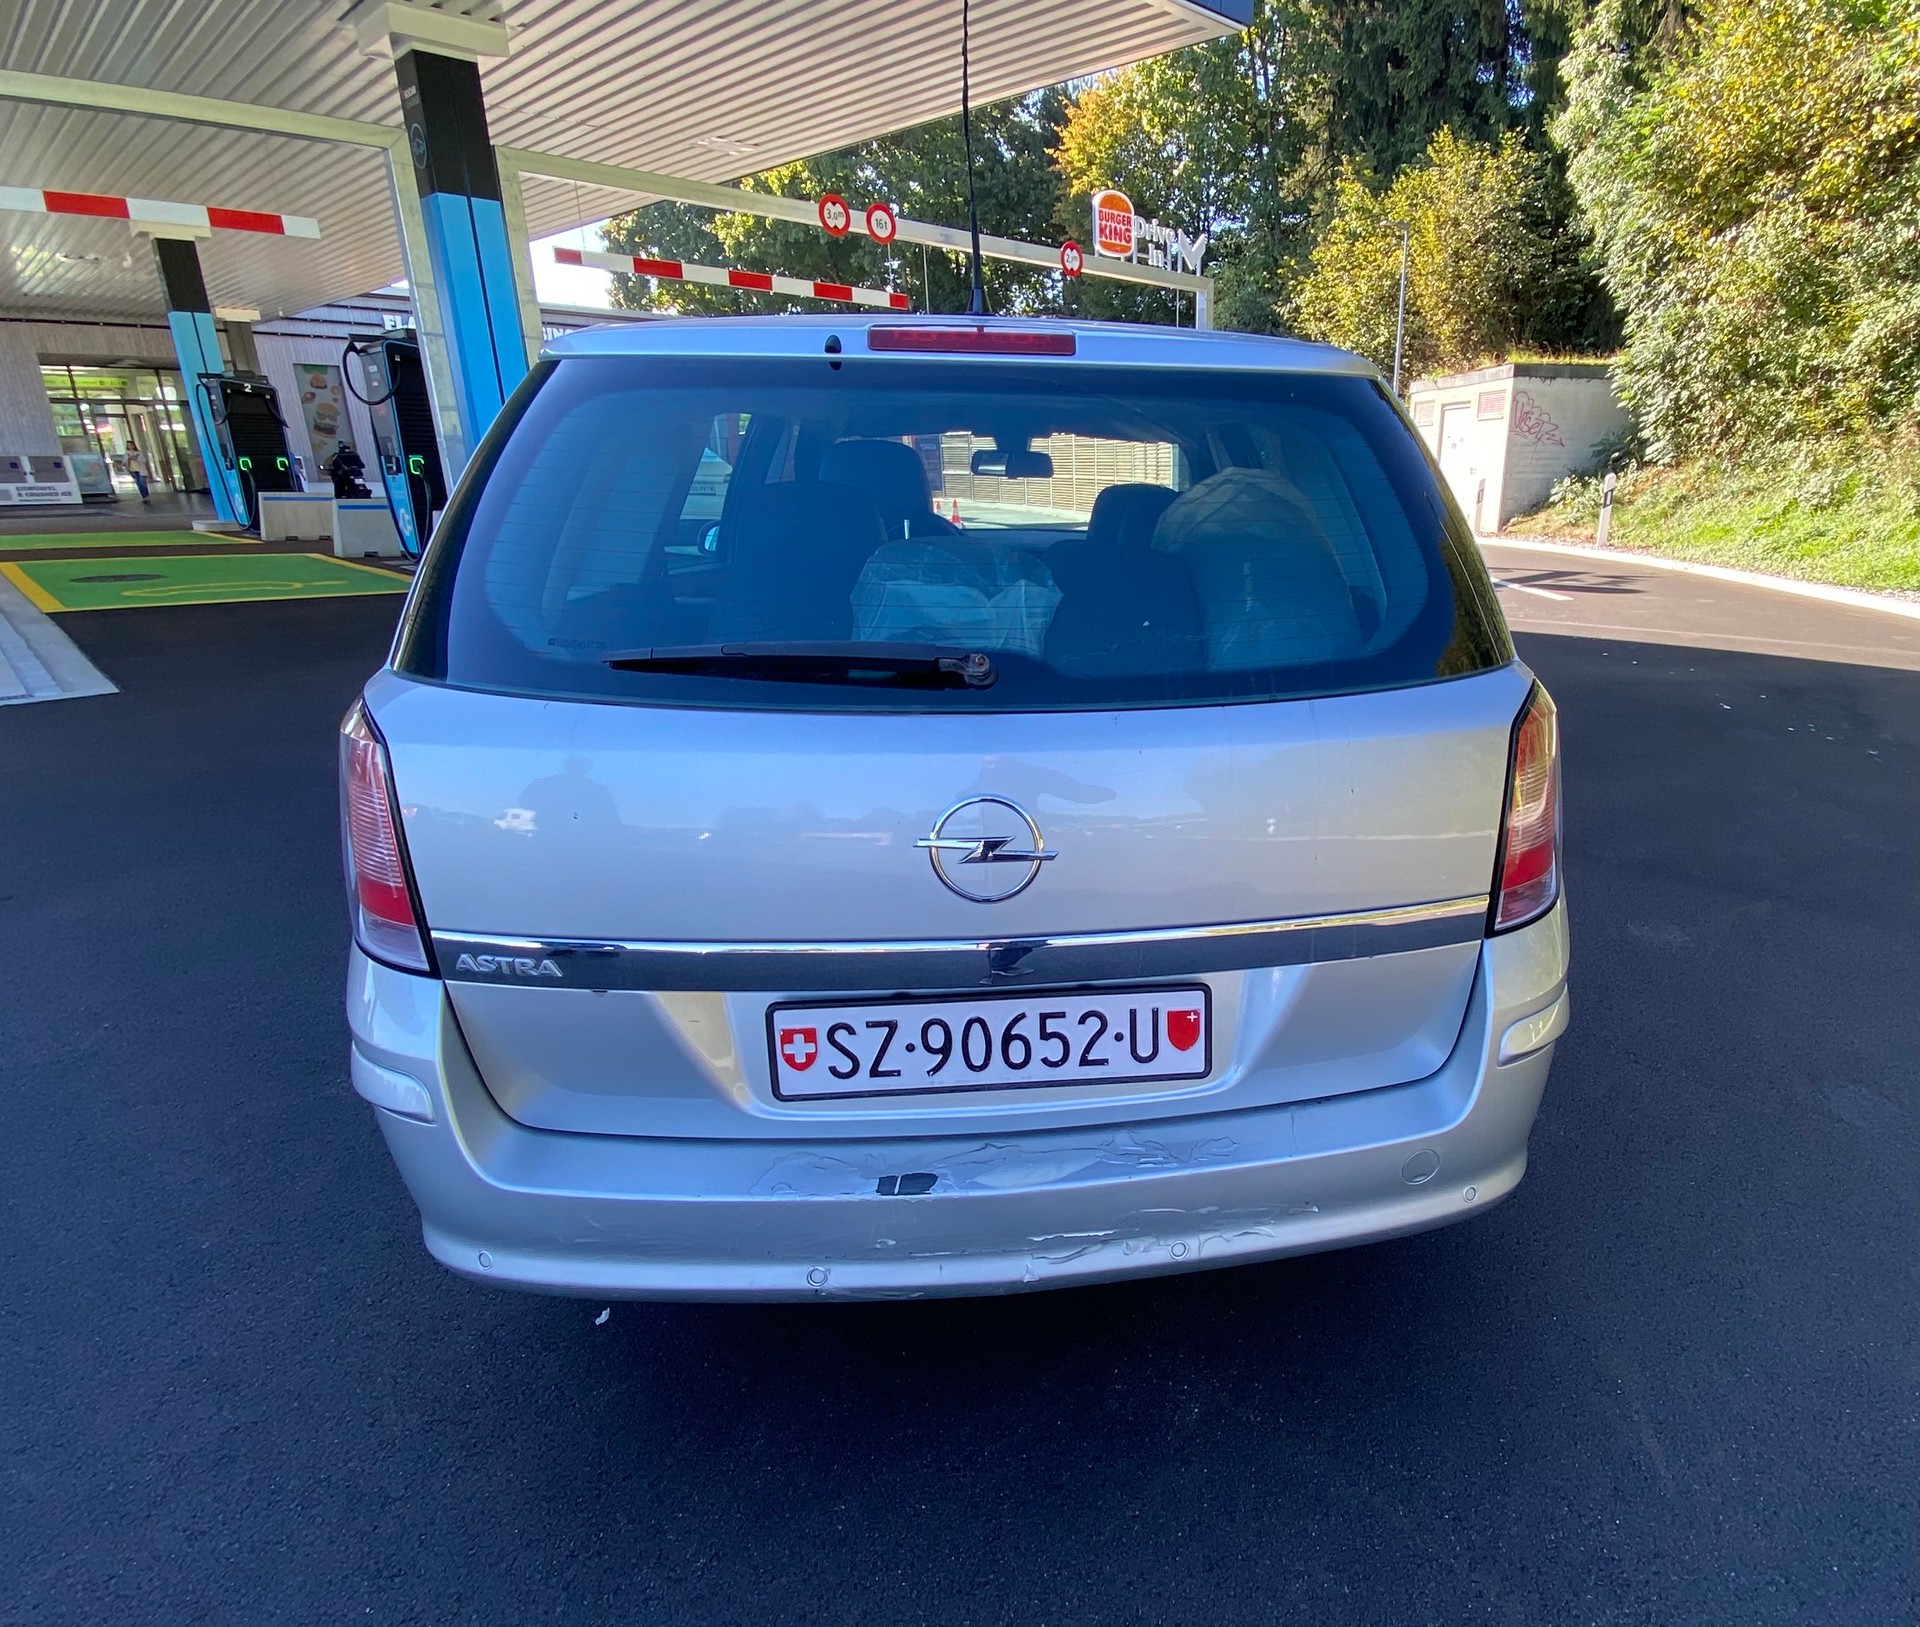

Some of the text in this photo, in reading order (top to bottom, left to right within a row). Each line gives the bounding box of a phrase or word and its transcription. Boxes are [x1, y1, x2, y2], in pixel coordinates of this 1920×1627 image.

[1098, 209, 1132, 228] BURGER
[1134, 214, 1177, 245] Drive
[1098, 222, 1132, 244] KING
[243, 383, 252, 393] 2
[455, 953, 564, 977] ASTRA
